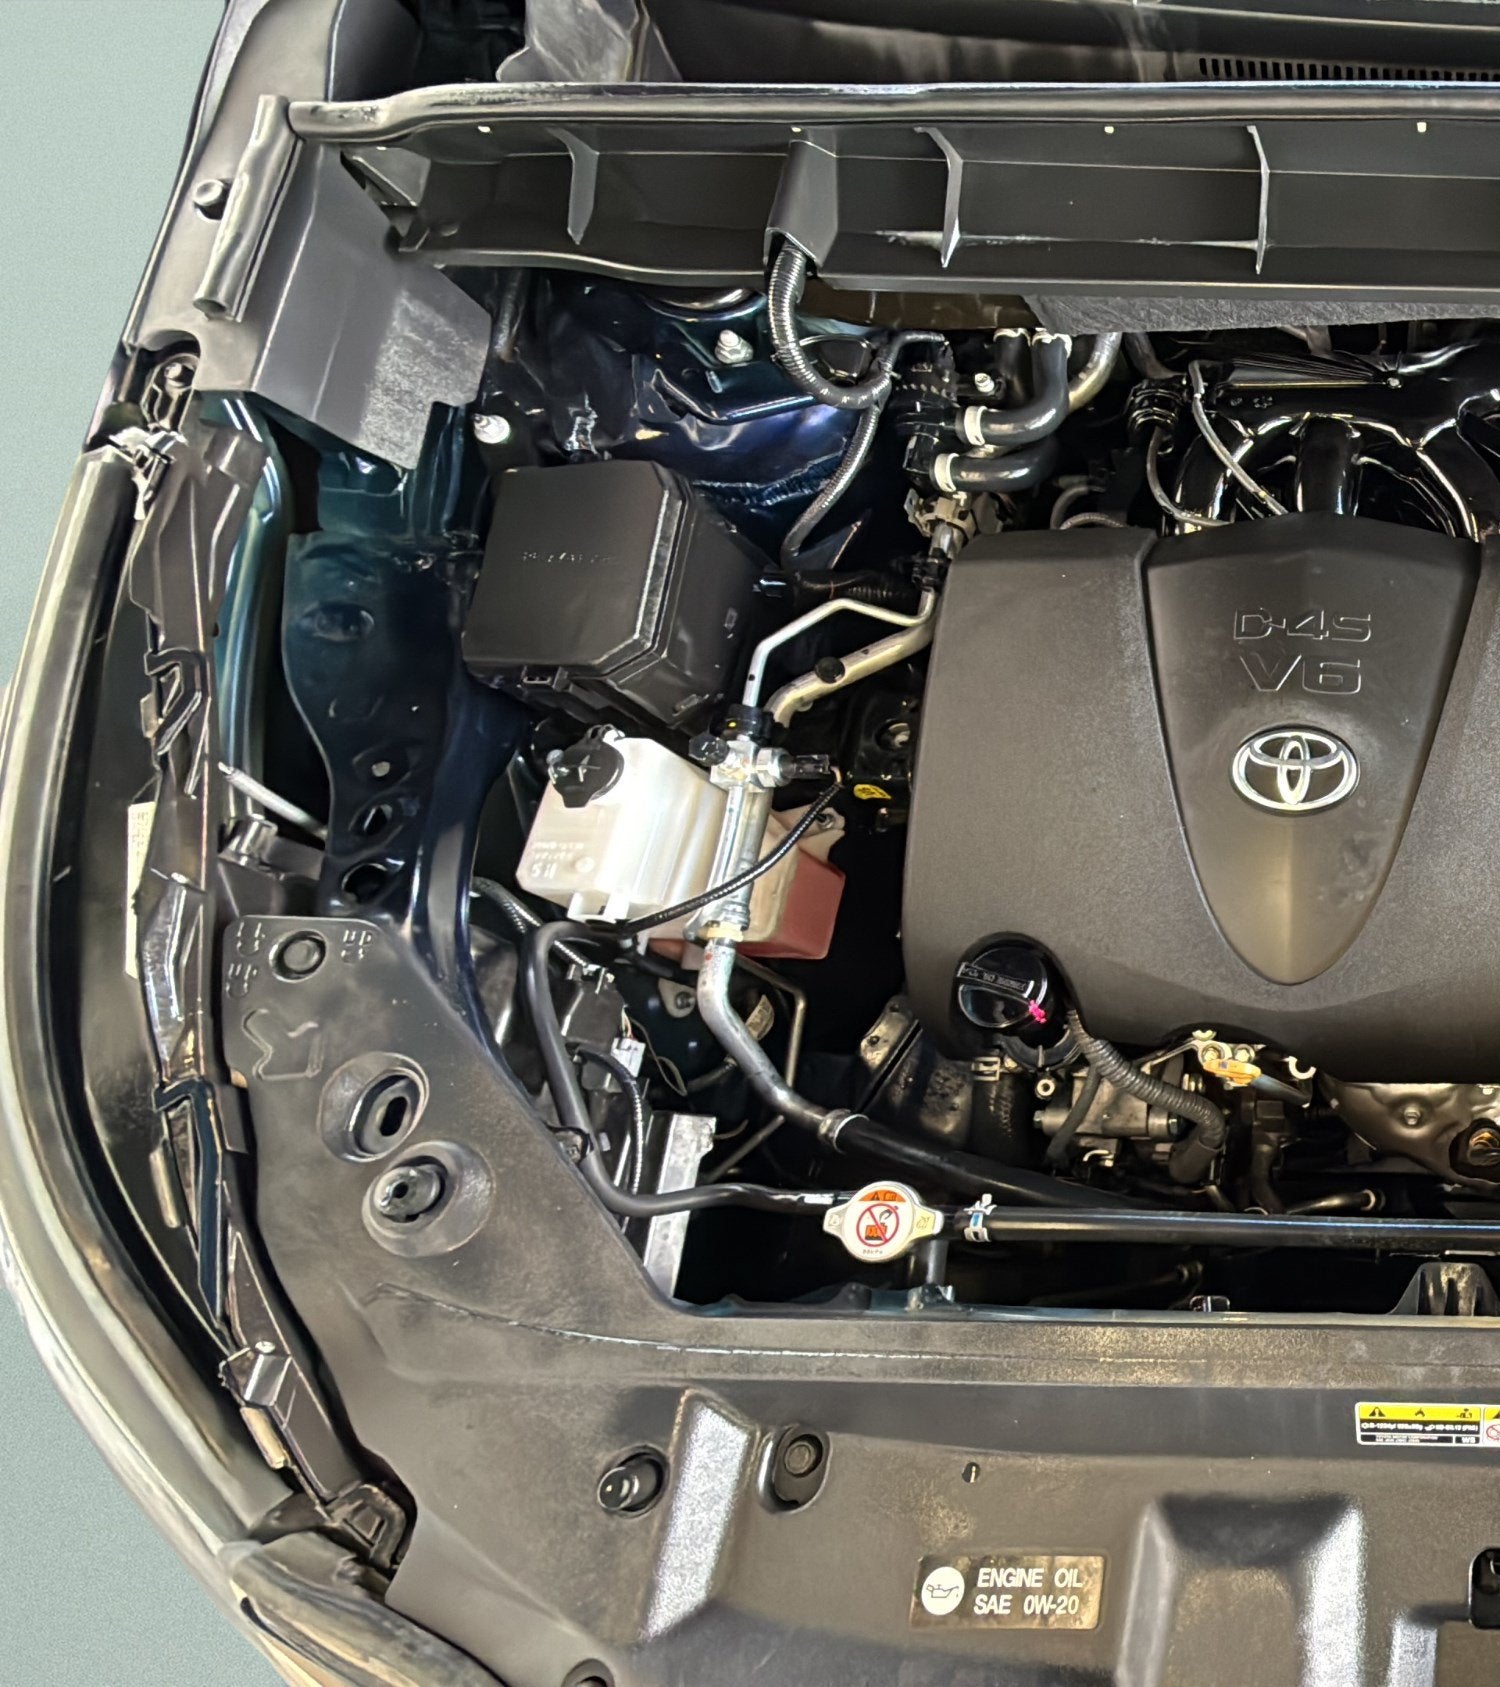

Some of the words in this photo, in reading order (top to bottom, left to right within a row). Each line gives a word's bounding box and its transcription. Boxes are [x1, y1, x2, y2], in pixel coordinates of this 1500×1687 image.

[1233, 606, 1372, 642] D-4S
[1239, 652, 1362, 695] V6
[977, 1567, 1044, 1588] ENGINE
[1054, 1568, 1083, 1588] OIL
[973, 1594, 1013, 1615] SAE
[1023, 1594, 1080, 1615] 0W-20
